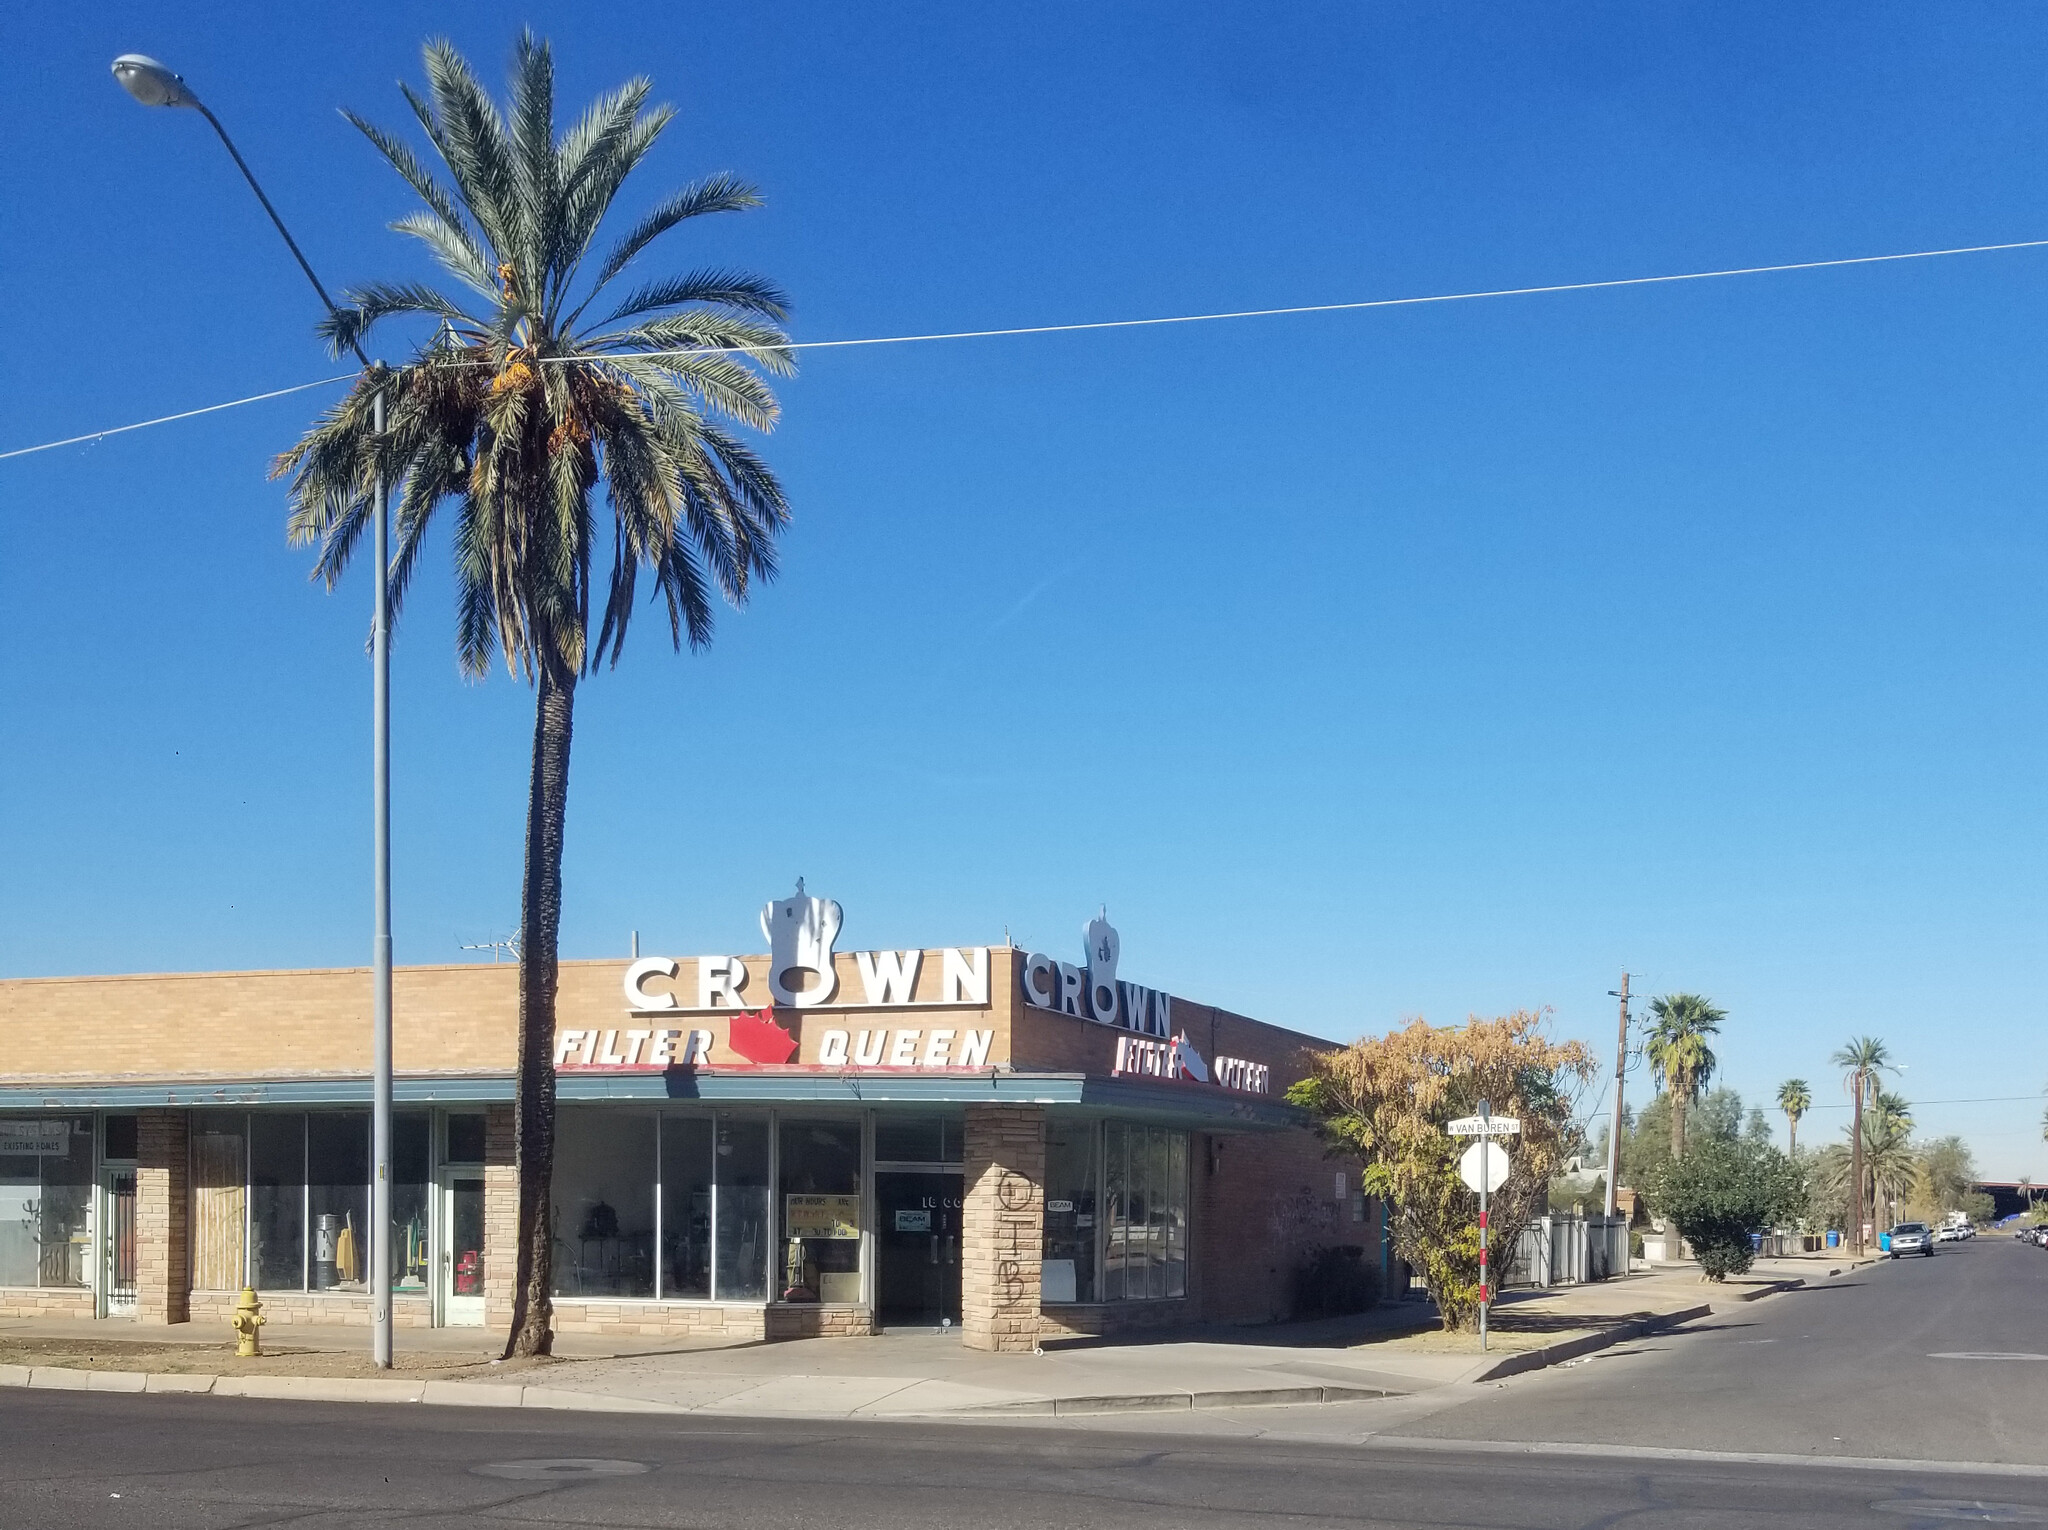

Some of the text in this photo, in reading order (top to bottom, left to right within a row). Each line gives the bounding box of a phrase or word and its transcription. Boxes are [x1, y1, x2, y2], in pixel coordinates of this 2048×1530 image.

[624, 947, 991, 1010] CROWN
[1024, 951, 1170, 1040] CROWN
[555, 1029, 996, 1067] FILTER QUEEN
[1214, 1055, 1270, 1094] QUEEN
[1456, 1123, 1475, 1133] VAN
[1477, 1123, 1510, 1133] BUREN
[3, 1141, 34, 1151] EXISTING
[805, 1197, 826, 1206] HOURS
[1049, 1201, 1072, 1209] BEAM
[899, 1215, 926, 1223] BEAM
